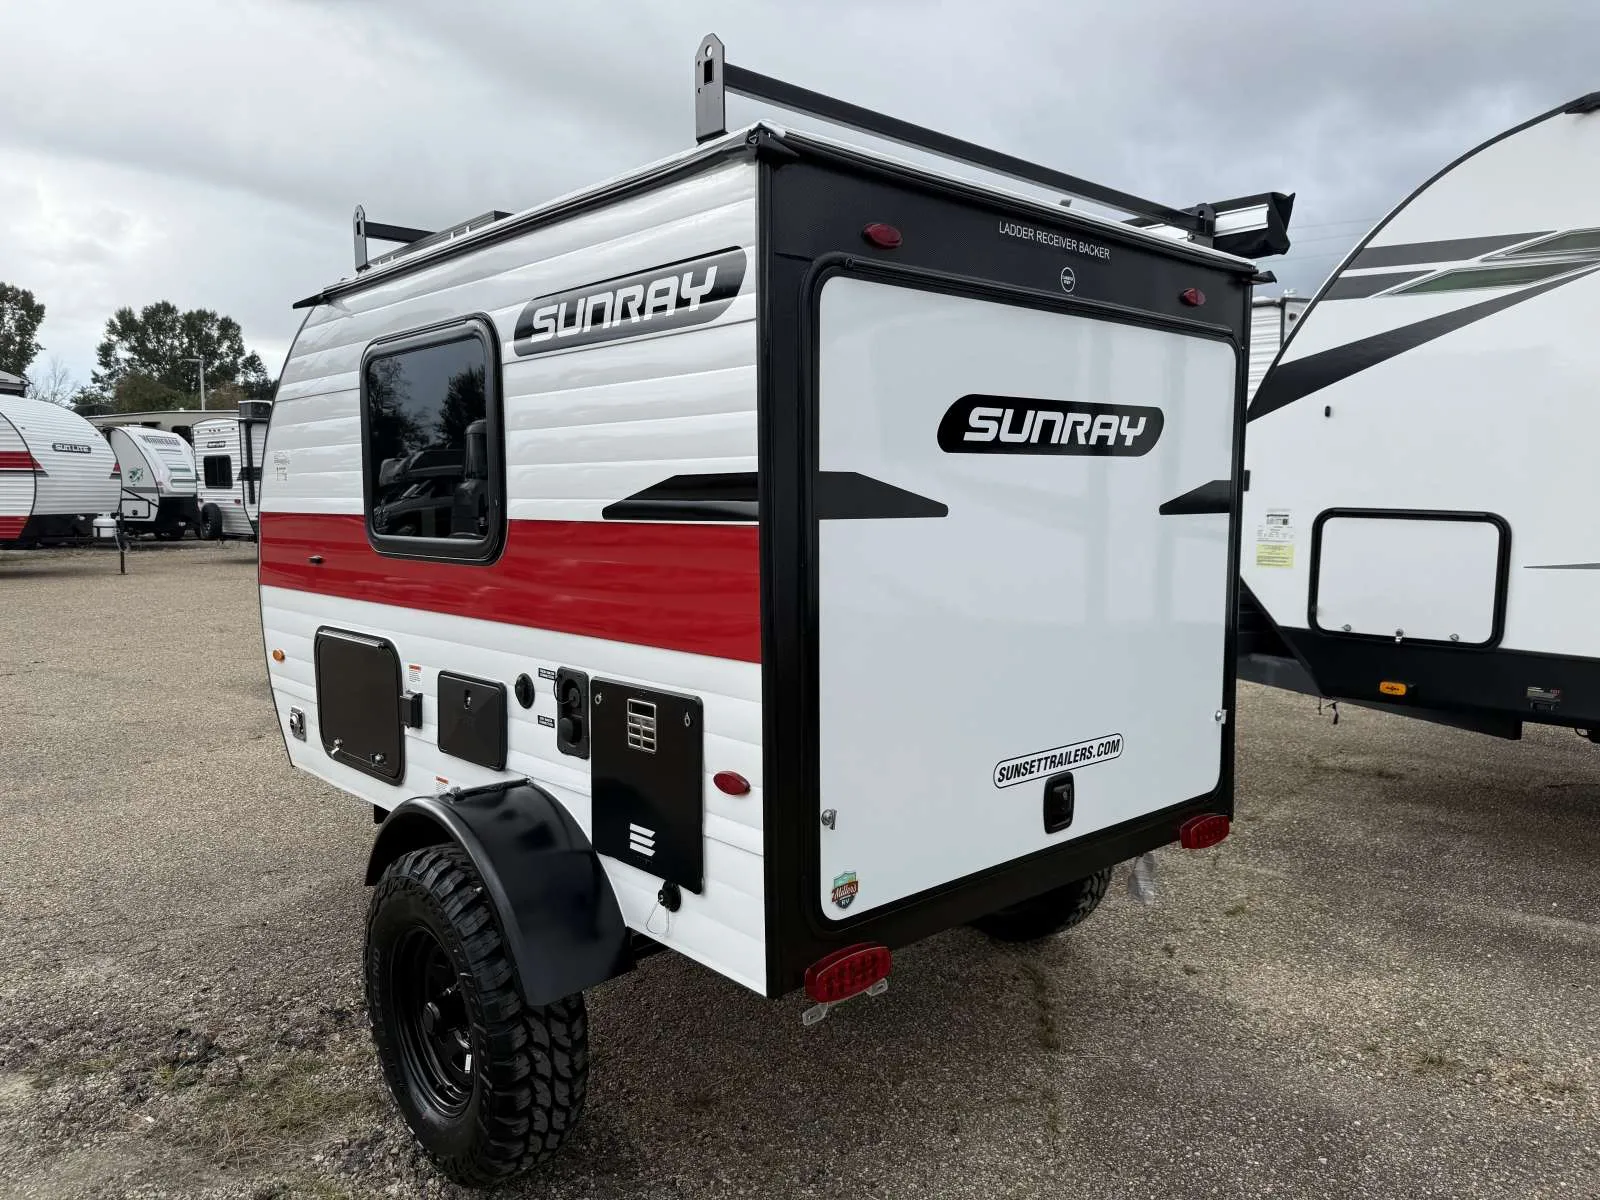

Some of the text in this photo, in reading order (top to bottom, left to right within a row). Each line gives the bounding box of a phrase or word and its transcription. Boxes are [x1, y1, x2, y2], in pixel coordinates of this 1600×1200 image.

[999, 220, 1110, 260] LADDER RECEIVER BACKER
[531, 266, 718, 343] SUNRAY
[963, 406, 1147, 446] SUNRAY
[997, 738, 1121, 783] SUNSETTRAILERS.COM
